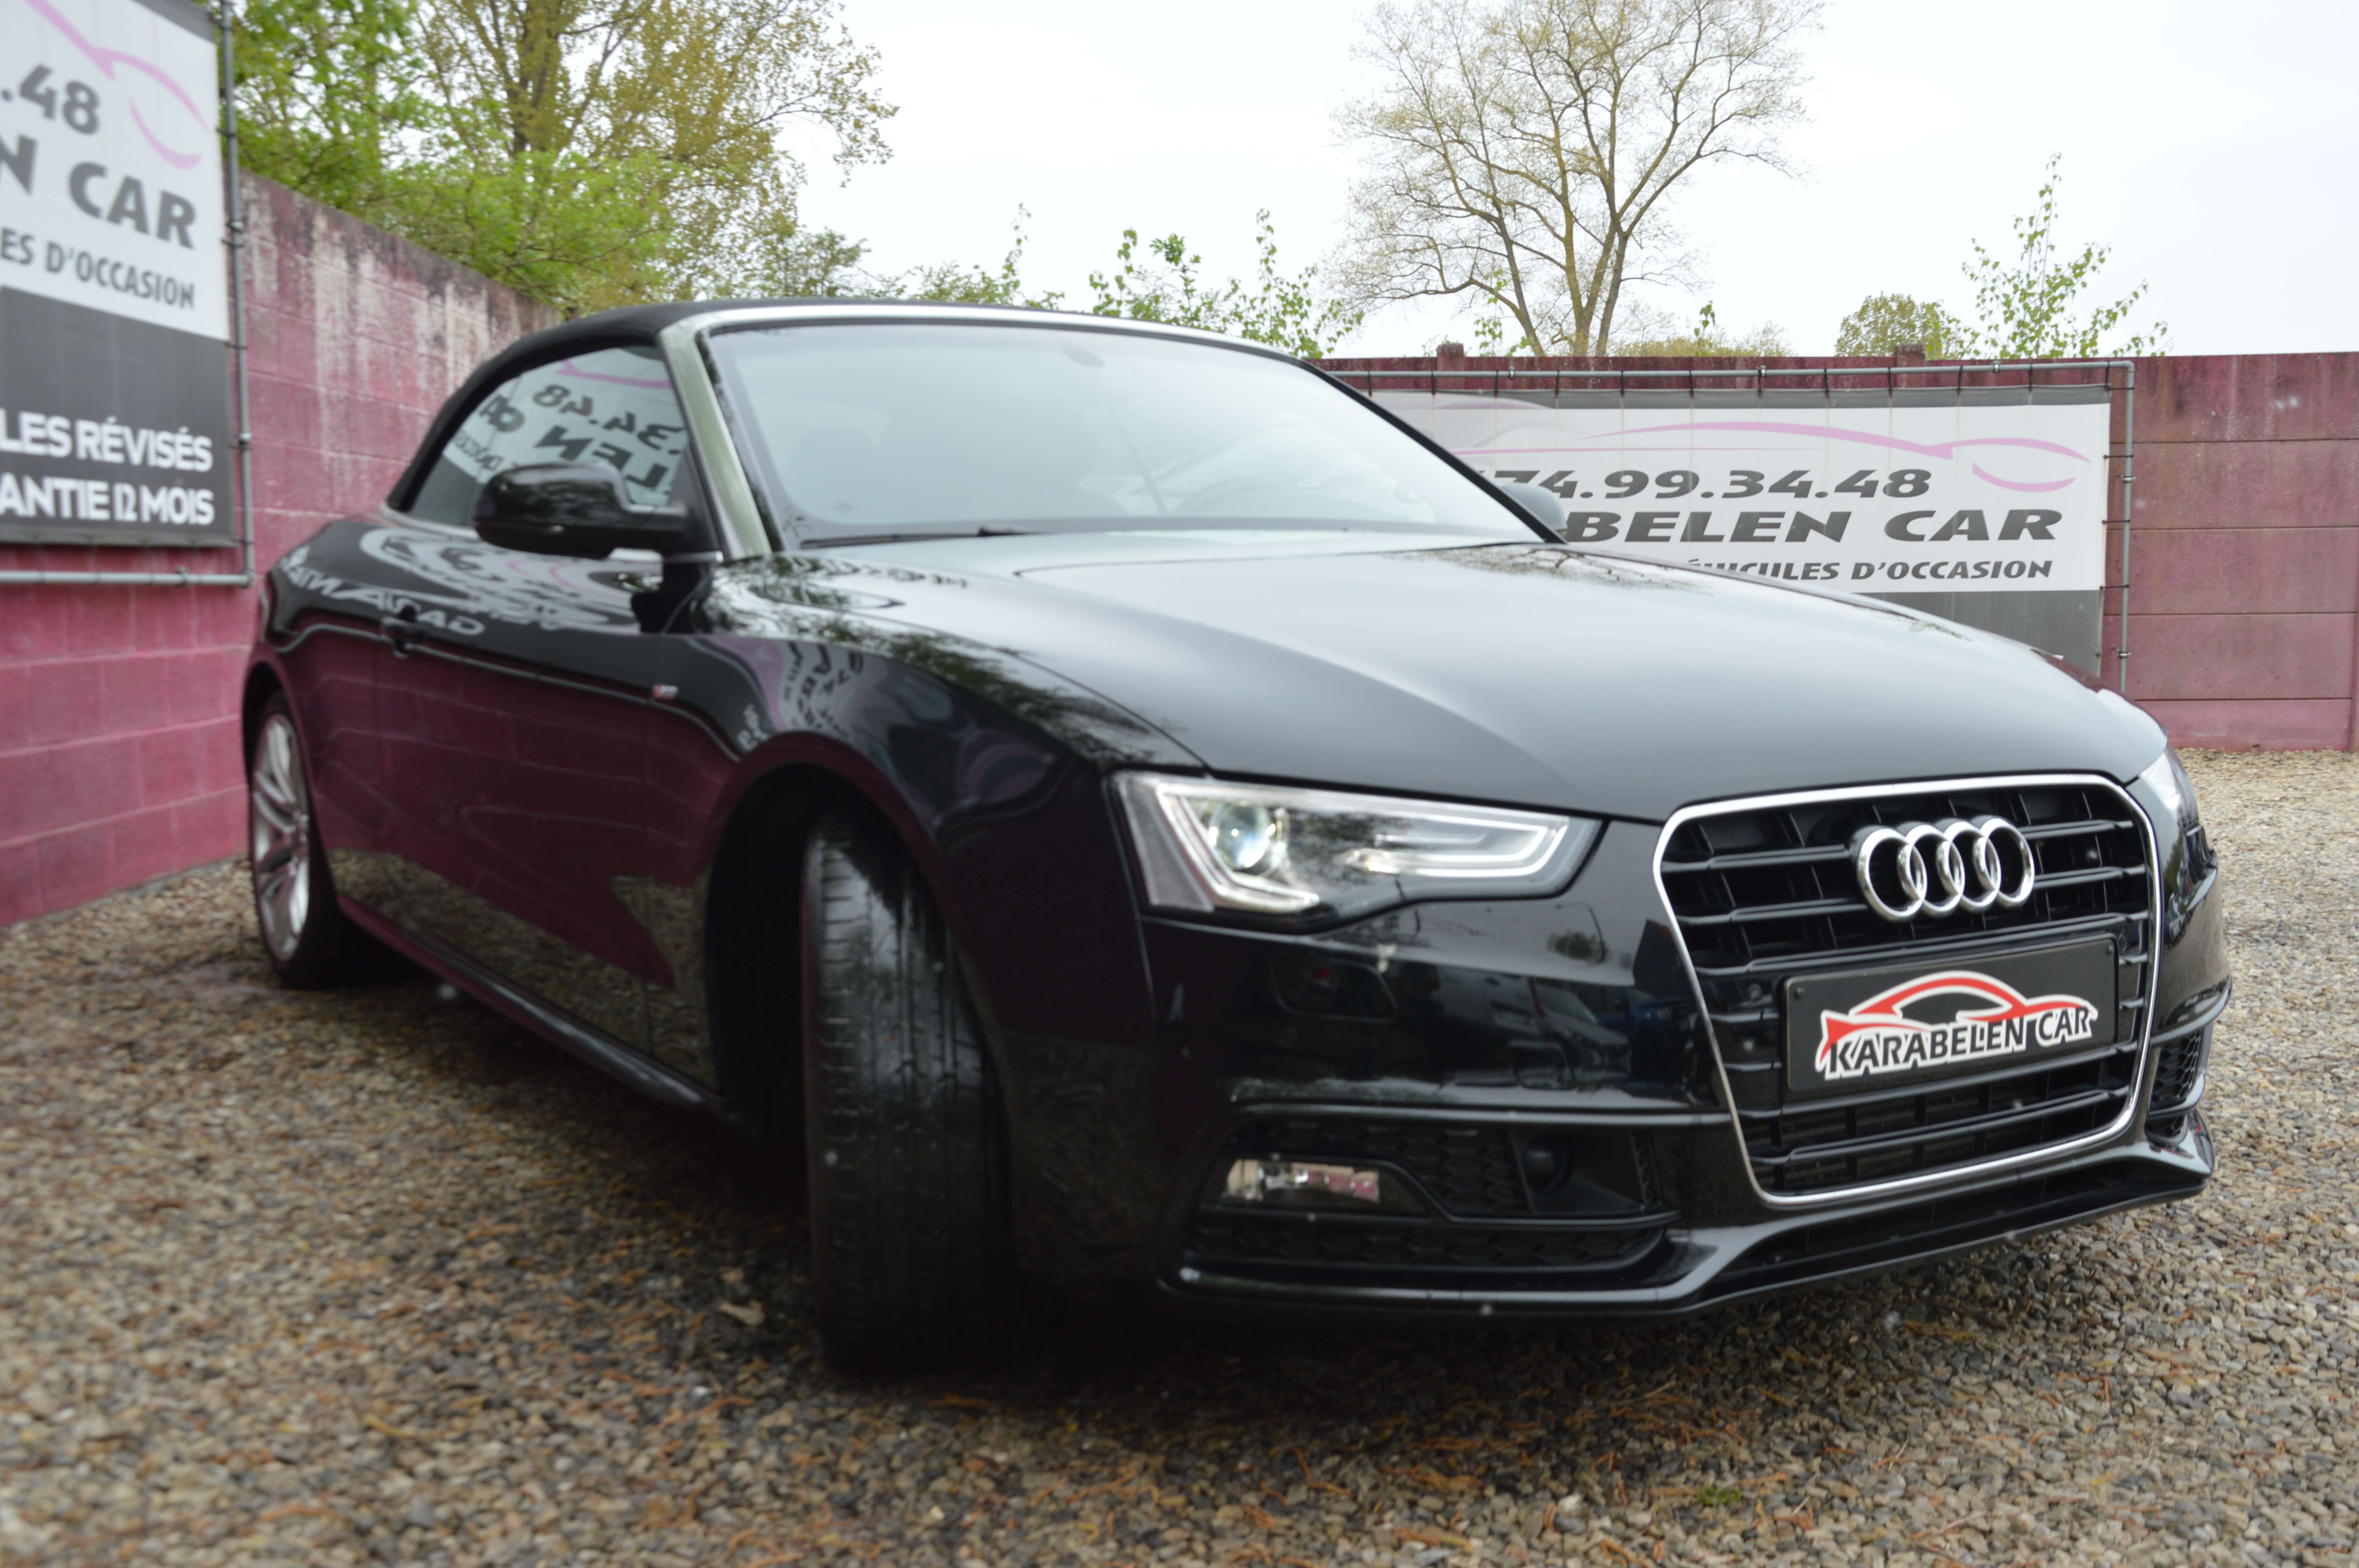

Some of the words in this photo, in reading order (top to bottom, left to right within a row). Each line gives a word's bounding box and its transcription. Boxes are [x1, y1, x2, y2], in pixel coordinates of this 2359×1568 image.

[68, 162, 196, 250] CAR
[45, 240, 195, 308] D'OCCASION
[75, 415, 213, 472] RÉVISÉS
[140, 485, 214, 525] MOIS
[1480, 470, 1932, 499] 74.99.34.48
[1884, 509, 2063, 542] CAR
[1851, 560, 2053, 580] D'OCCASION
[1829, 1016, 2025, 1074] KARABELEN
[2040, 1006, 2090, 1040] CAR
